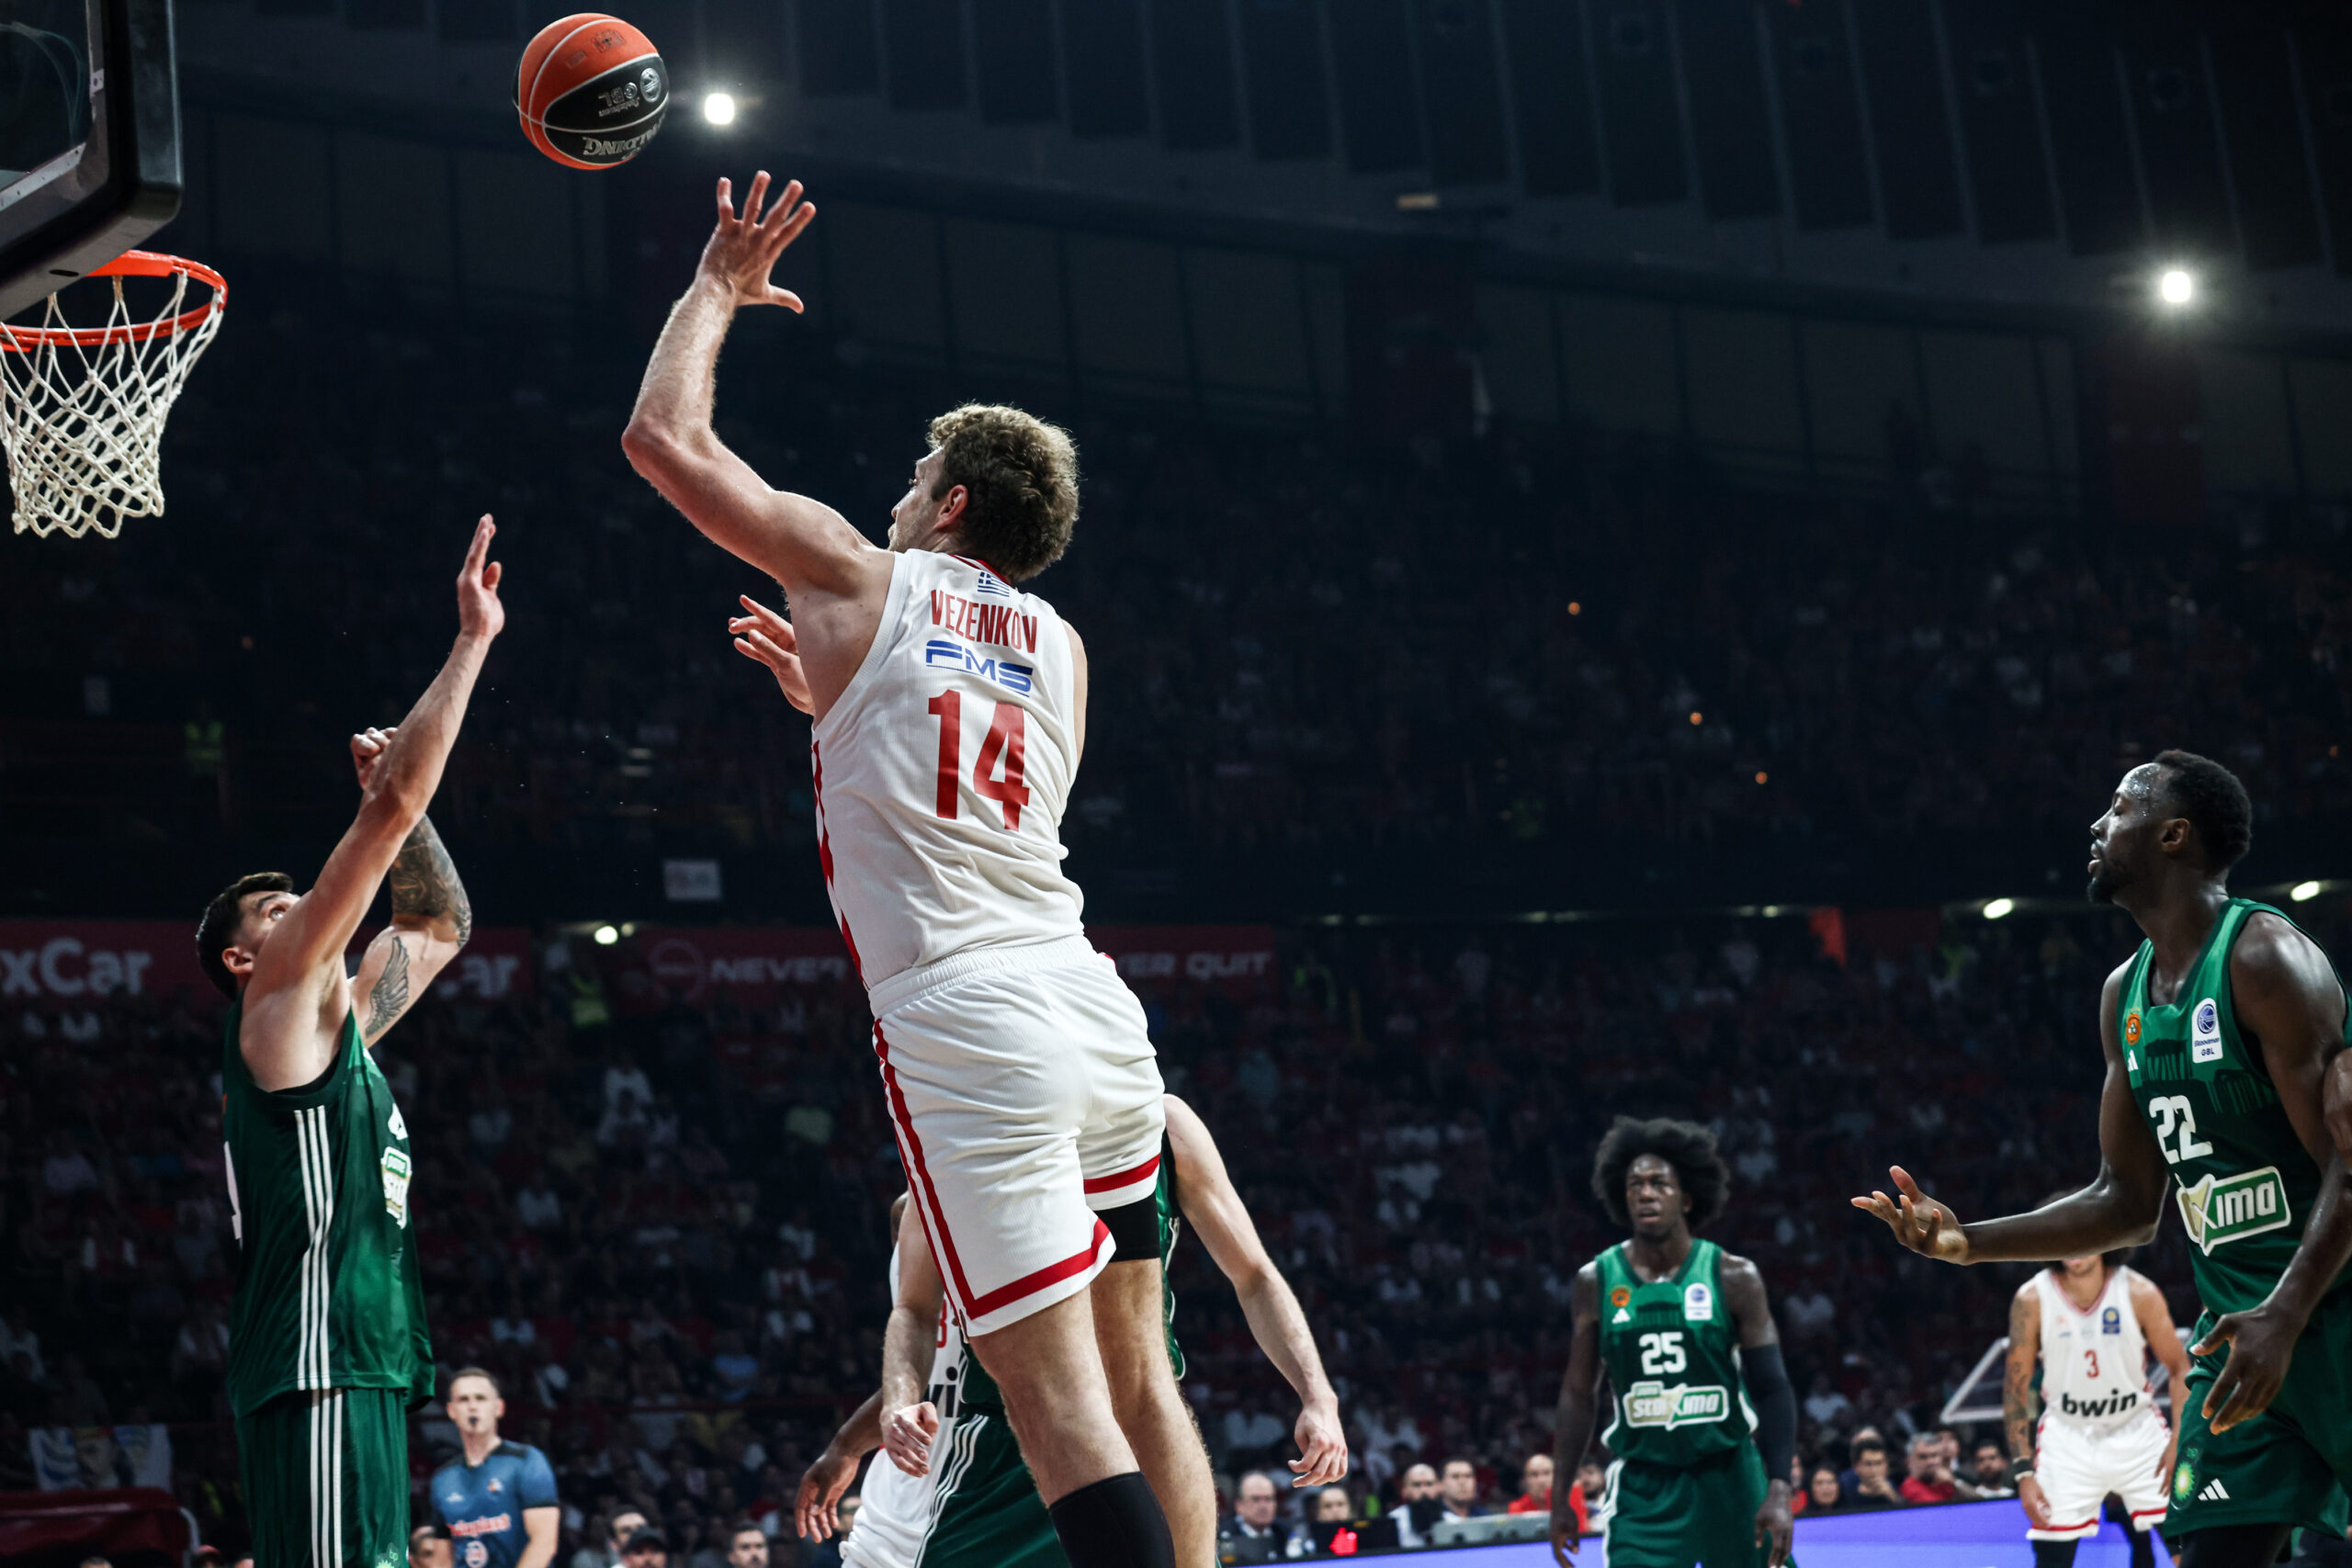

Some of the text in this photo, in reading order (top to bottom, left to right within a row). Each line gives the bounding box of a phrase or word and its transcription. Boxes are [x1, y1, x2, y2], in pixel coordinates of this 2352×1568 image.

[931, 589, 1037, 654] VEZENKOV
[926, 640, 1033, 692] FMS
[928, 689, 1030, 831] 14
[1185, 952, 1272, 980] QUIT
[2149, 1095, 2213, 1165] 22
[1638, 1331, 1687, 1376] 25
[2084, 1349, 2100, 1379] 3
[2062, 1387, 2137, 1417] bwin
